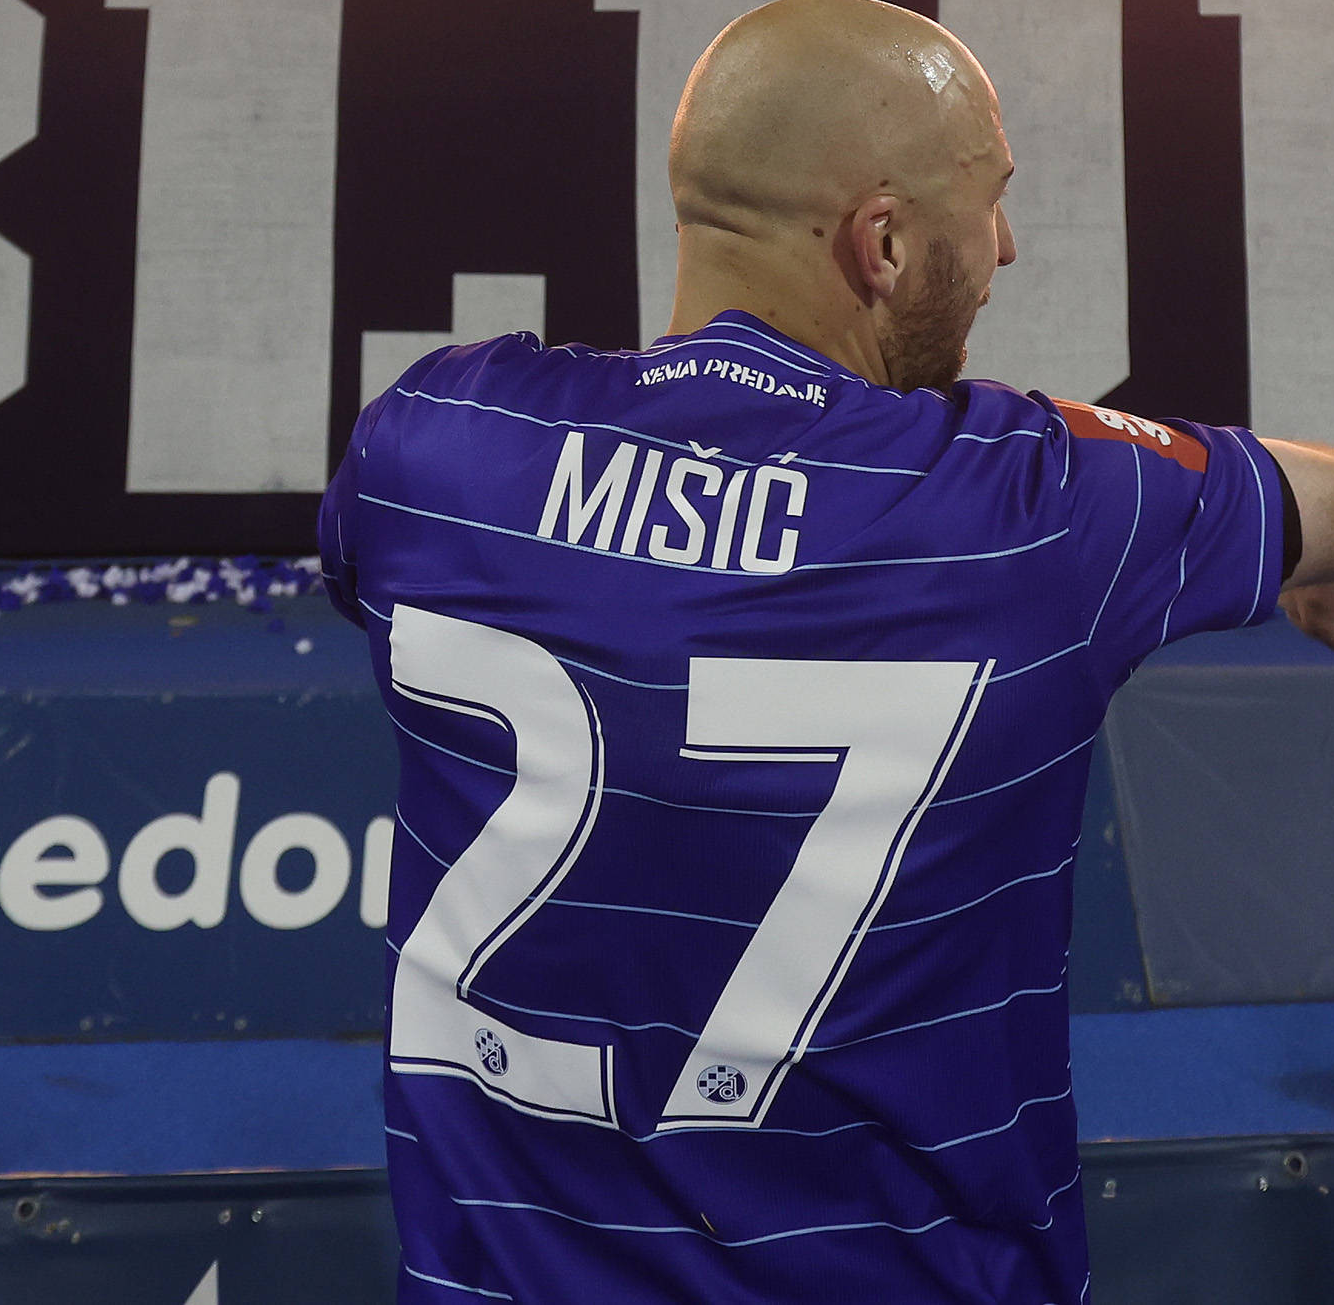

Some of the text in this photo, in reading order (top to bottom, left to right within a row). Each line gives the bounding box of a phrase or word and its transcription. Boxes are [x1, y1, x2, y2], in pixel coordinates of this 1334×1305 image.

[703, 358, 828, 408] PREDAJE
[536, 431, 808, 573] MIŠIĆ
[389, 603, 996, 1131] 27
